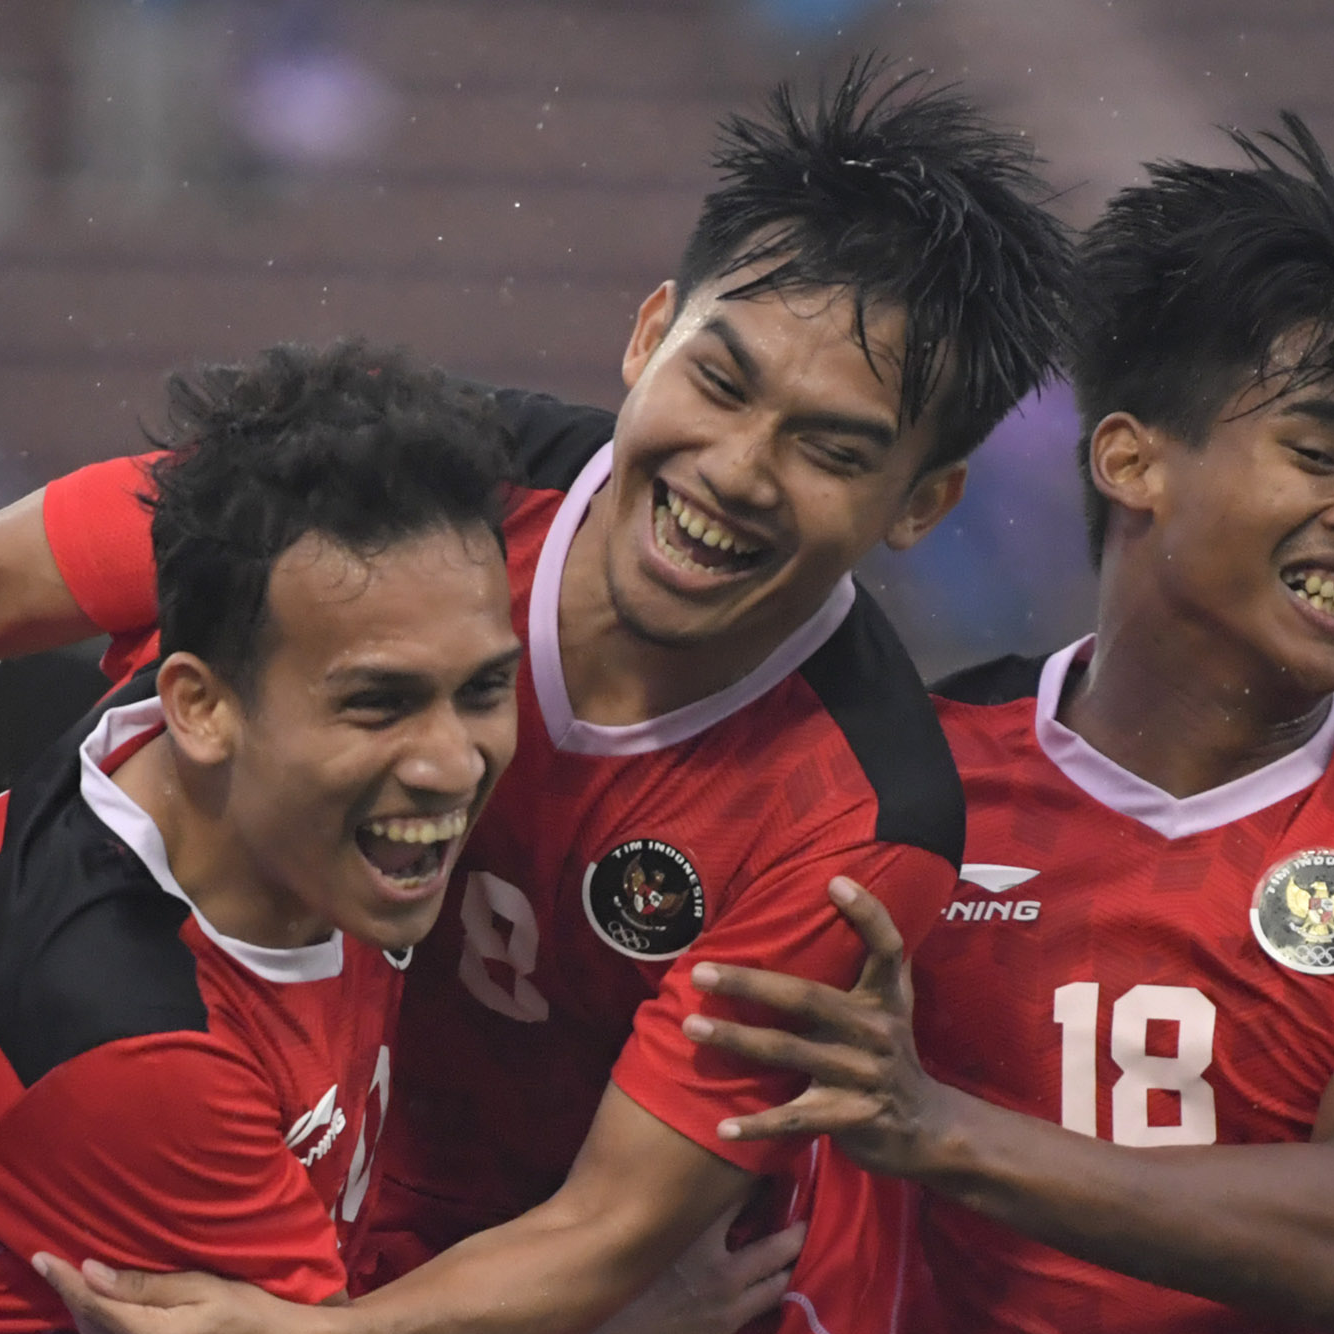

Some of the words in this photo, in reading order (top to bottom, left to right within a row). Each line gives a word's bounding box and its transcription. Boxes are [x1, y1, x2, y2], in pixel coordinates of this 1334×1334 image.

[612, 841, 643, 858] TIM
[1265, 867, 1291, 894] TIM
[459, 870, 549, 1022] 8
[1053, 981, 1217, 1147] 18
